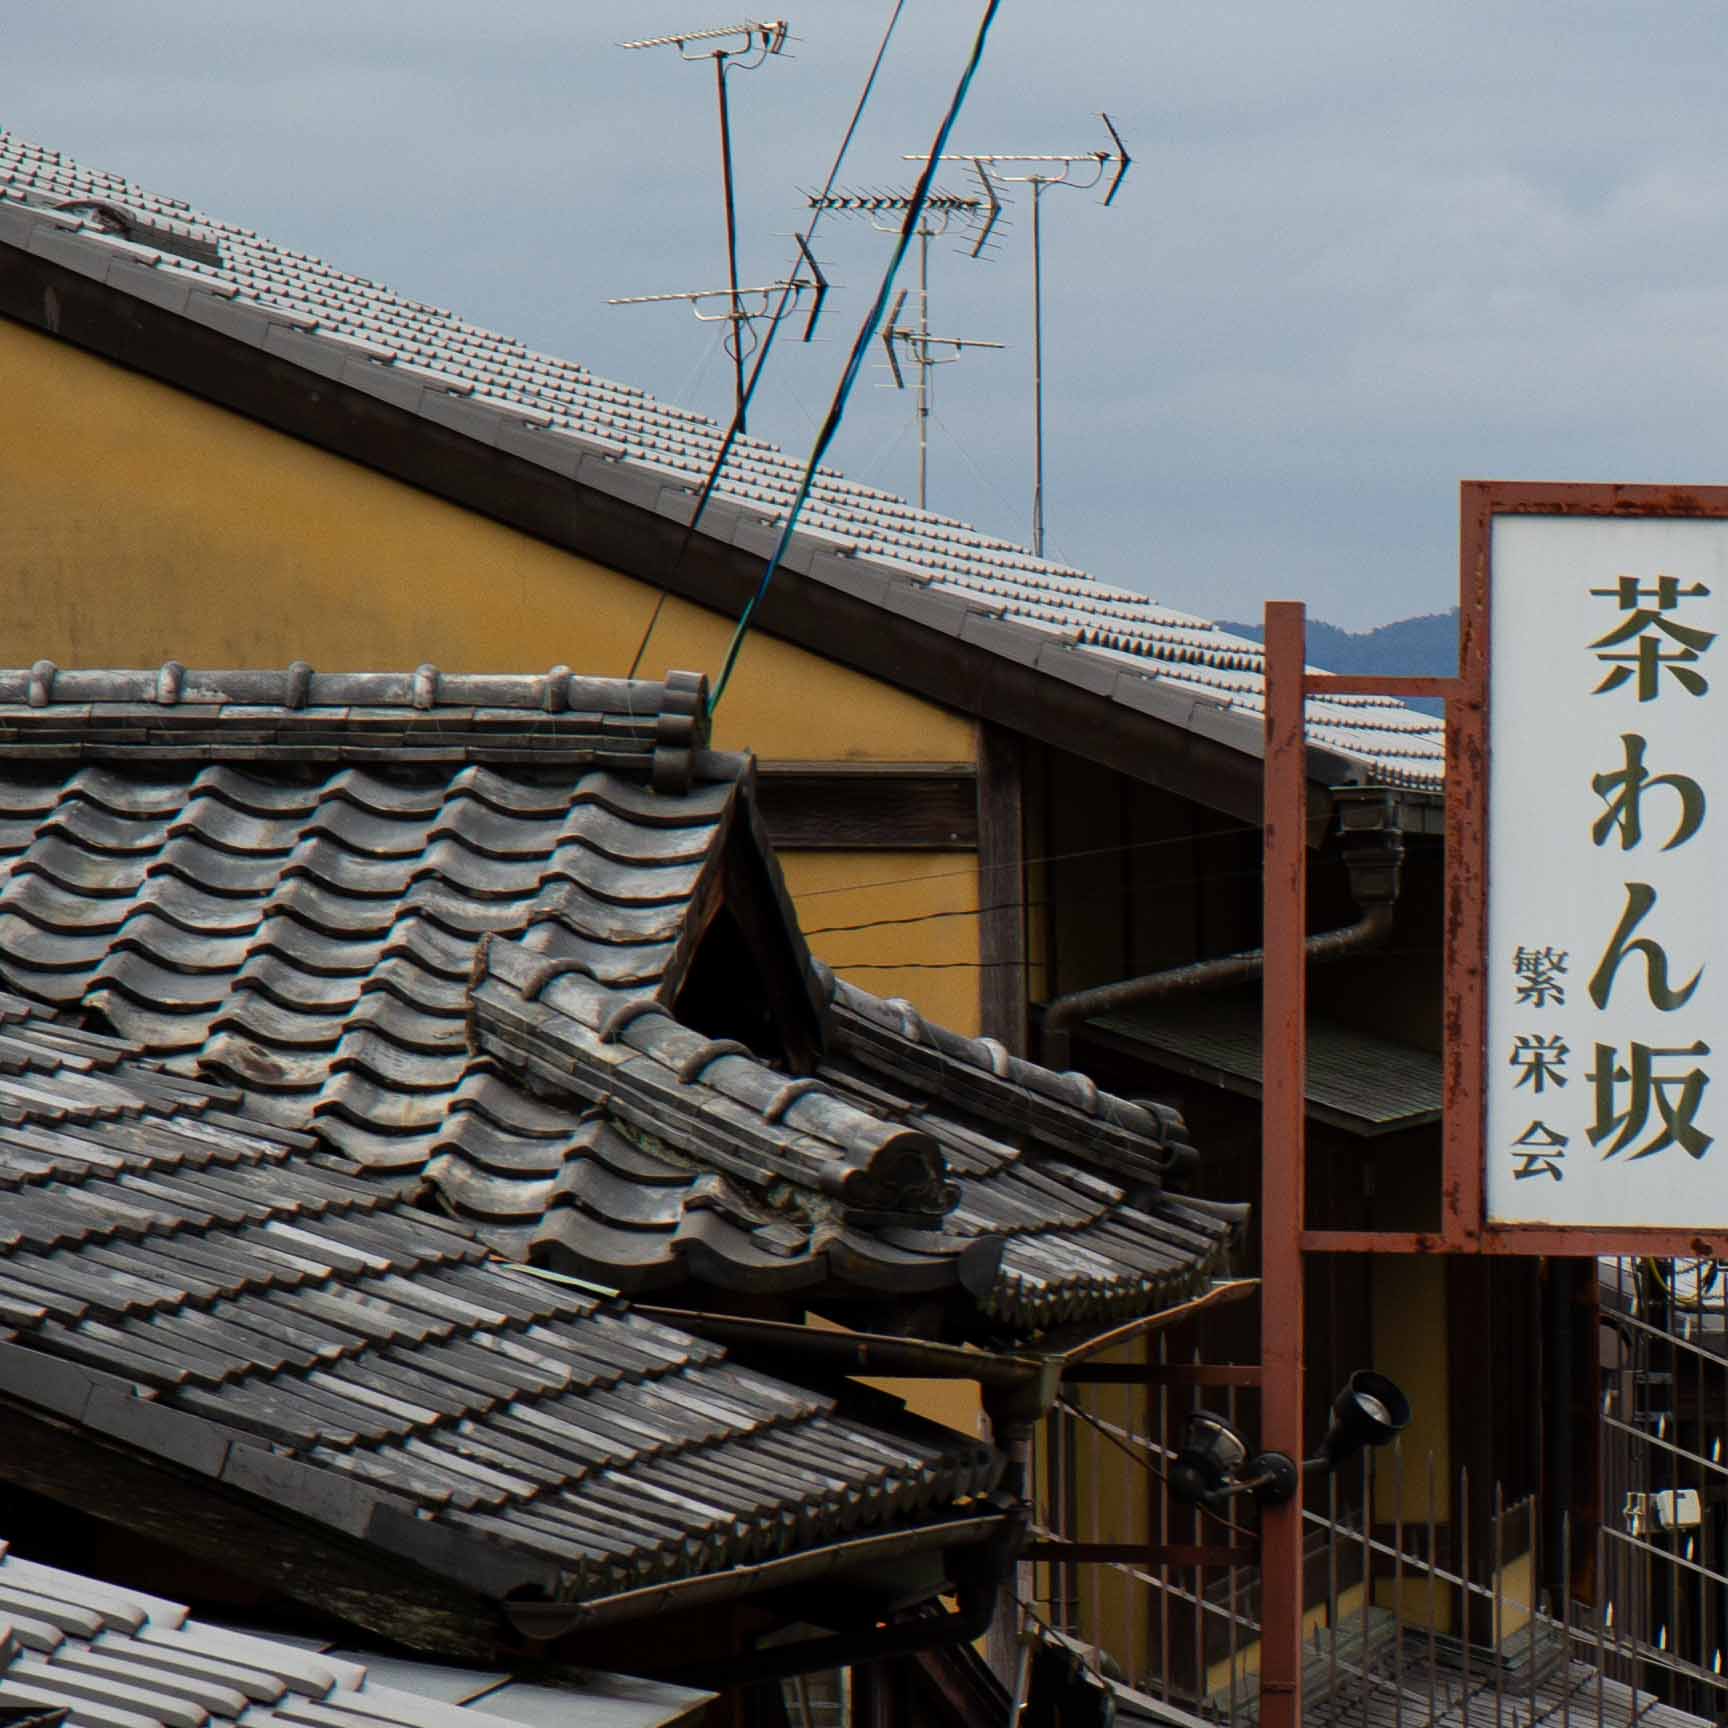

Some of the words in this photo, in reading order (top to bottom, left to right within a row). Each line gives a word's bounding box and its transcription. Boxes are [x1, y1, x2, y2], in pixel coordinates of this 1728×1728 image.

[1507, 946, 1570, 1181] 繁栄会
[1584, 575, 1718, 1161] 茶わん坂
